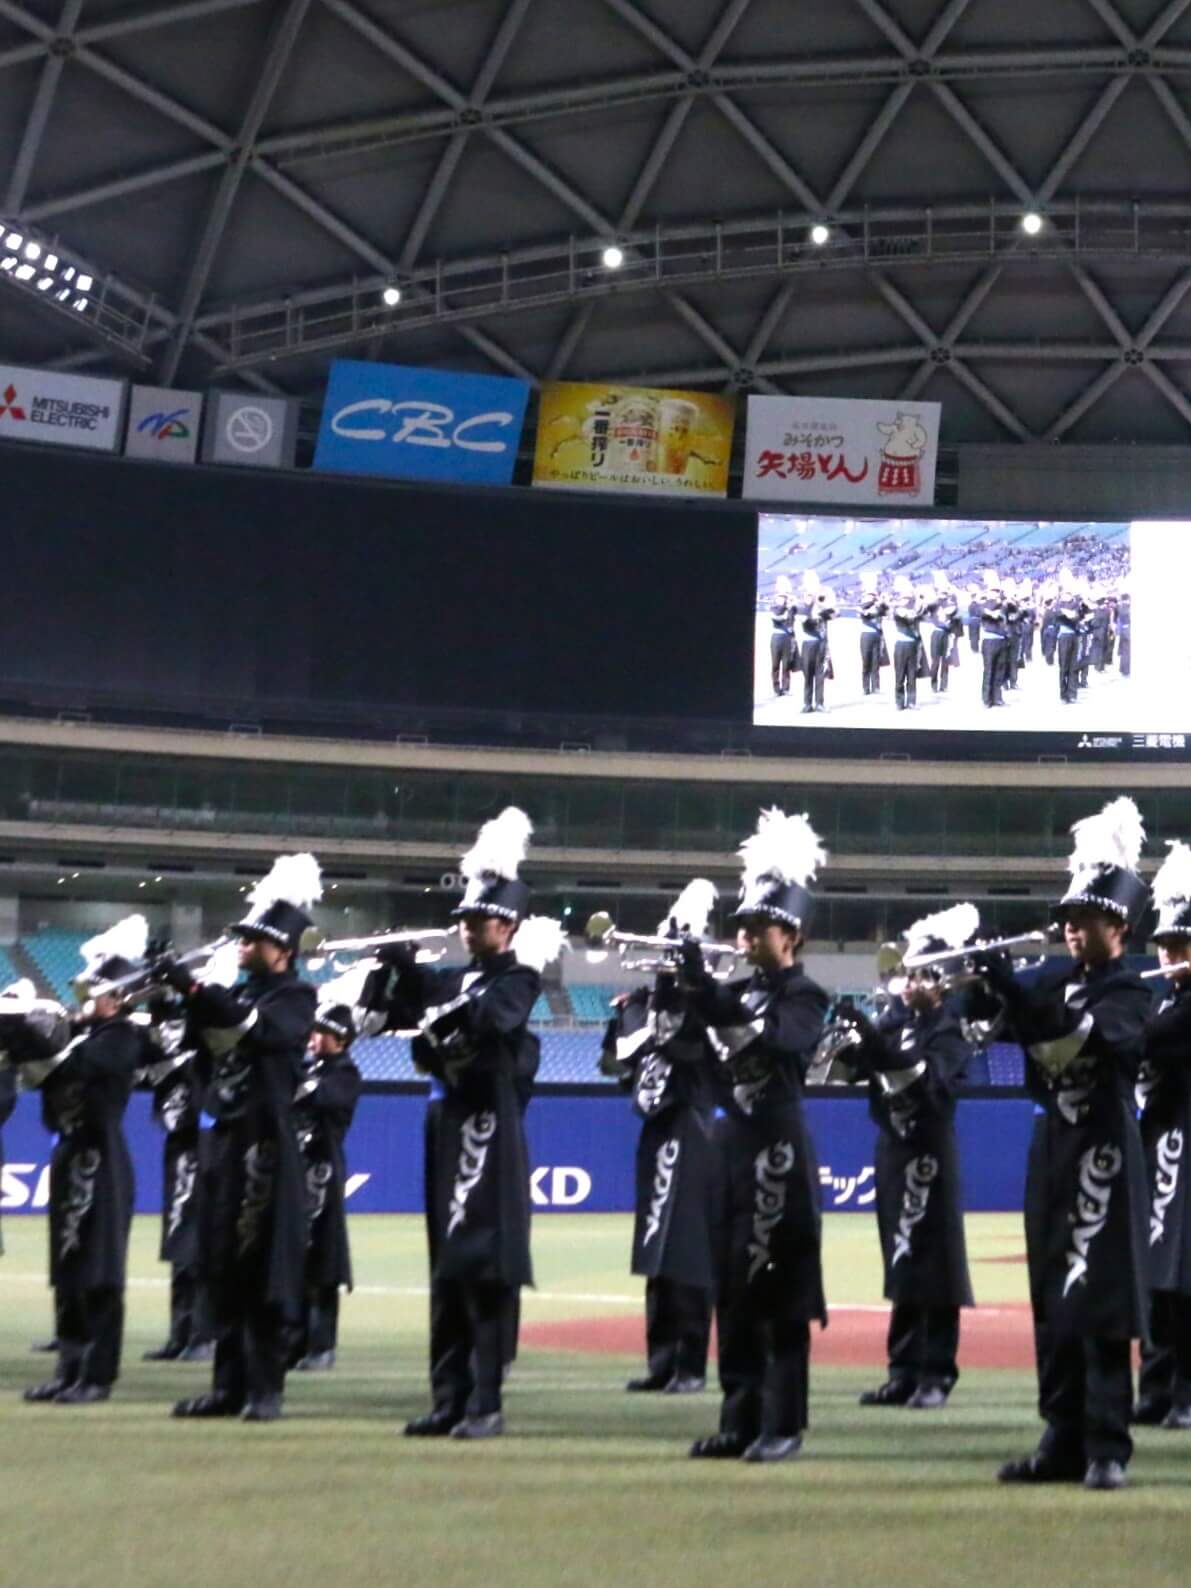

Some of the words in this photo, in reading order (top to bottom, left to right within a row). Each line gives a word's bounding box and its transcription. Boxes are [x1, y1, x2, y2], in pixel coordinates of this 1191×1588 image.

[32, 396, 110, 419] MITSUBISHI
[30, 410, 99, 431] ELECTRIC
[331, 398, 513, 452] CBC
[783, 432, 844, 449] みそかつ
[756, 450, 868, 483] 矢場とん
